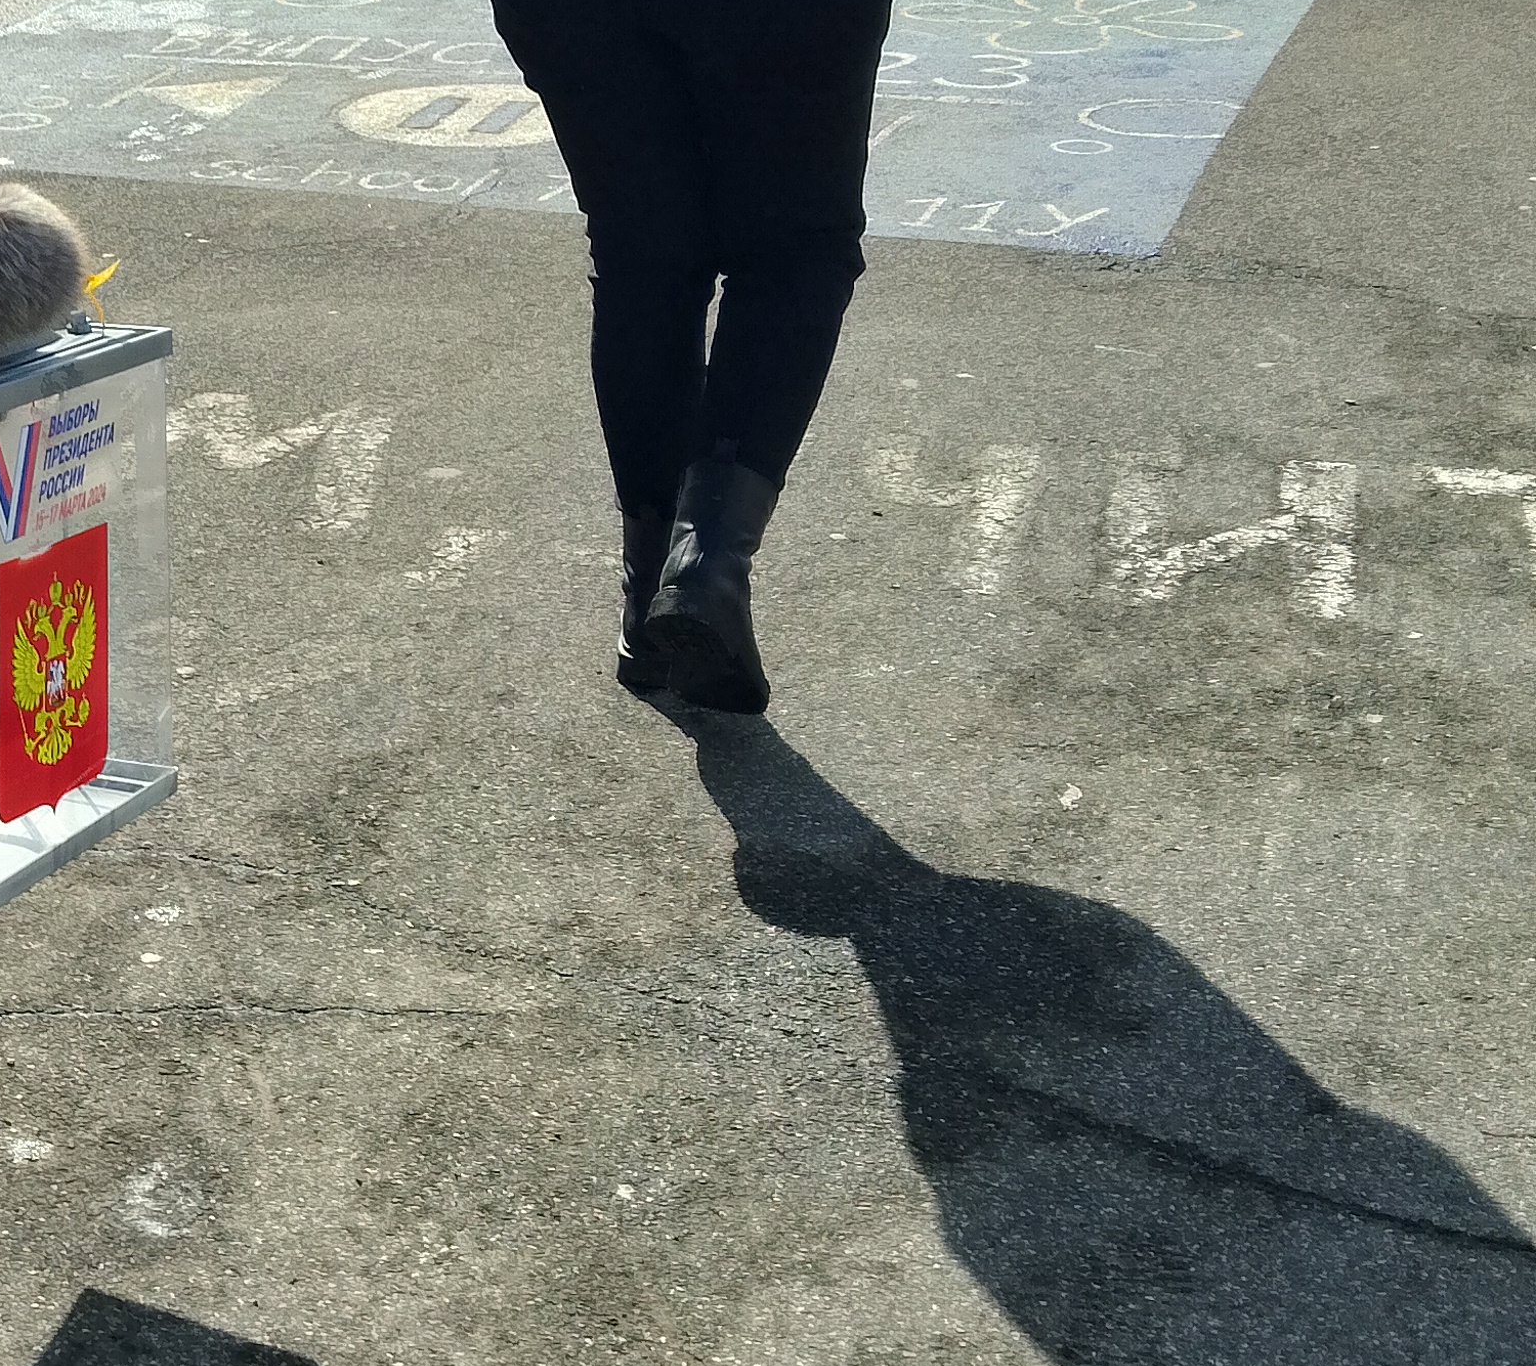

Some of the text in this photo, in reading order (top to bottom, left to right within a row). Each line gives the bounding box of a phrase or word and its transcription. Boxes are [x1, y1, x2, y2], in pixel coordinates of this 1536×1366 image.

[150, 35, 1032, 89] ВЫПУС 23
[48, 398, 100, 438] ВЫБОРЫ
[43, 422, 115, 471] ПРЕЗИДЕНТА
[38, 464, 86, 503] РОССИИ
[58, 490, 87, 518] МАРТА
[87, 482, 106, 508] 2024
